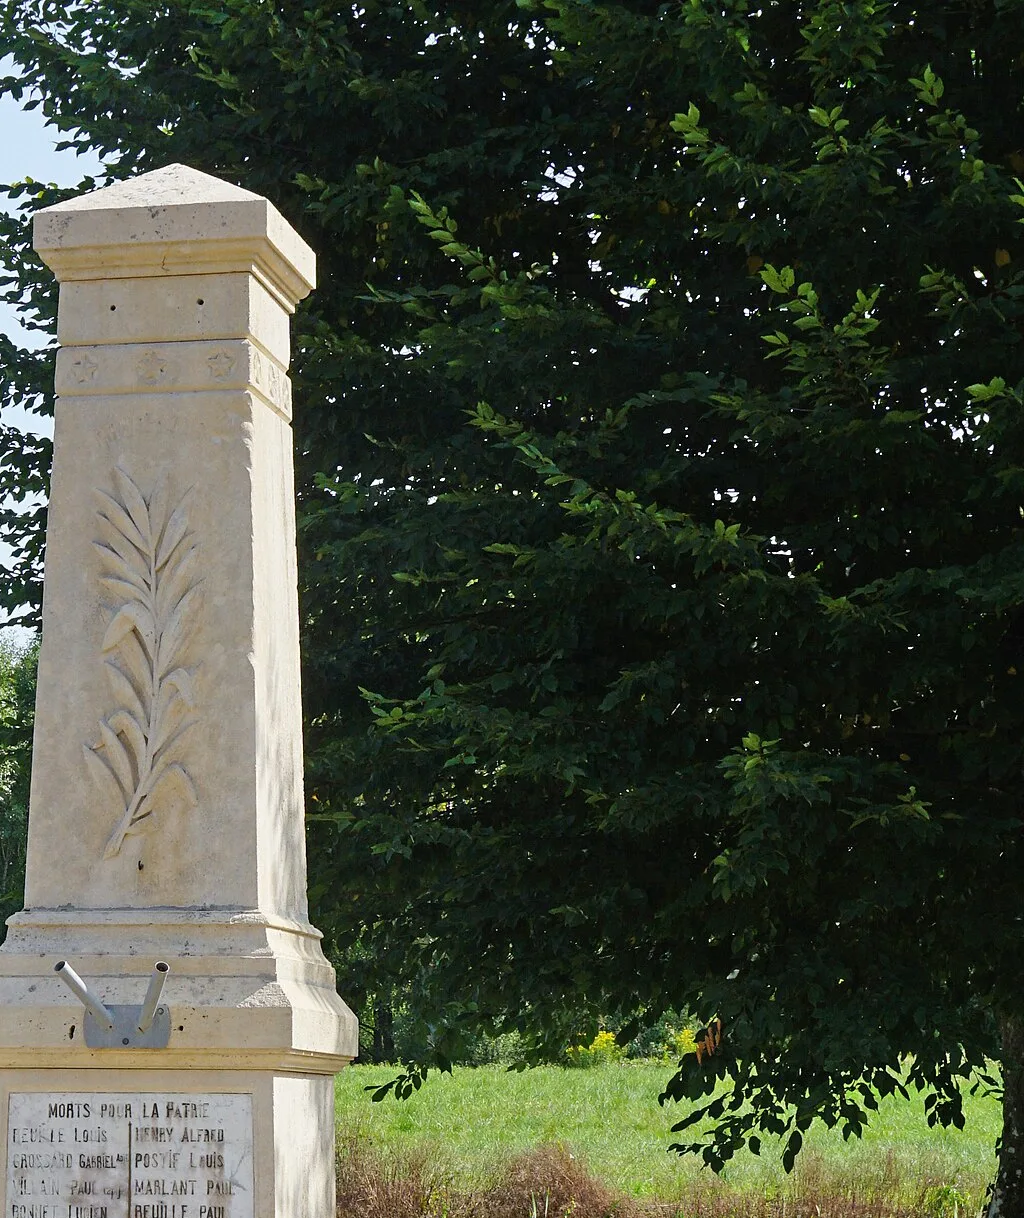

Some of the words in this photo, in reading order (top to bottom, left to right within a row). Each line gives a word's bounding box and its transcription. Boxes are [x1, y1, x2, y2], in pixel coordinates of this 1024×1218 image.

[48, 1103, 91, 1118] MORTS
[100, 1103, 132, 1118] POUR
[142, 1102, 159, 1118] LA
[166, 1101, 210, 1118] PATRIE
[74, 1126, 108, 1143] LOUIS
[135, 1127, 174, 1143] HENRY
[180, 1127, 224, 1143] ALFRED
[79, 1153, 116, 1169] GABRIEL
[189, 1152, 224, 1169] LOUIS
[70, 1179, 98, 1196] PAUL
[134, 1179, 197, 1196] MARLANT
[206, 1179, 235, 1196] PAUL
